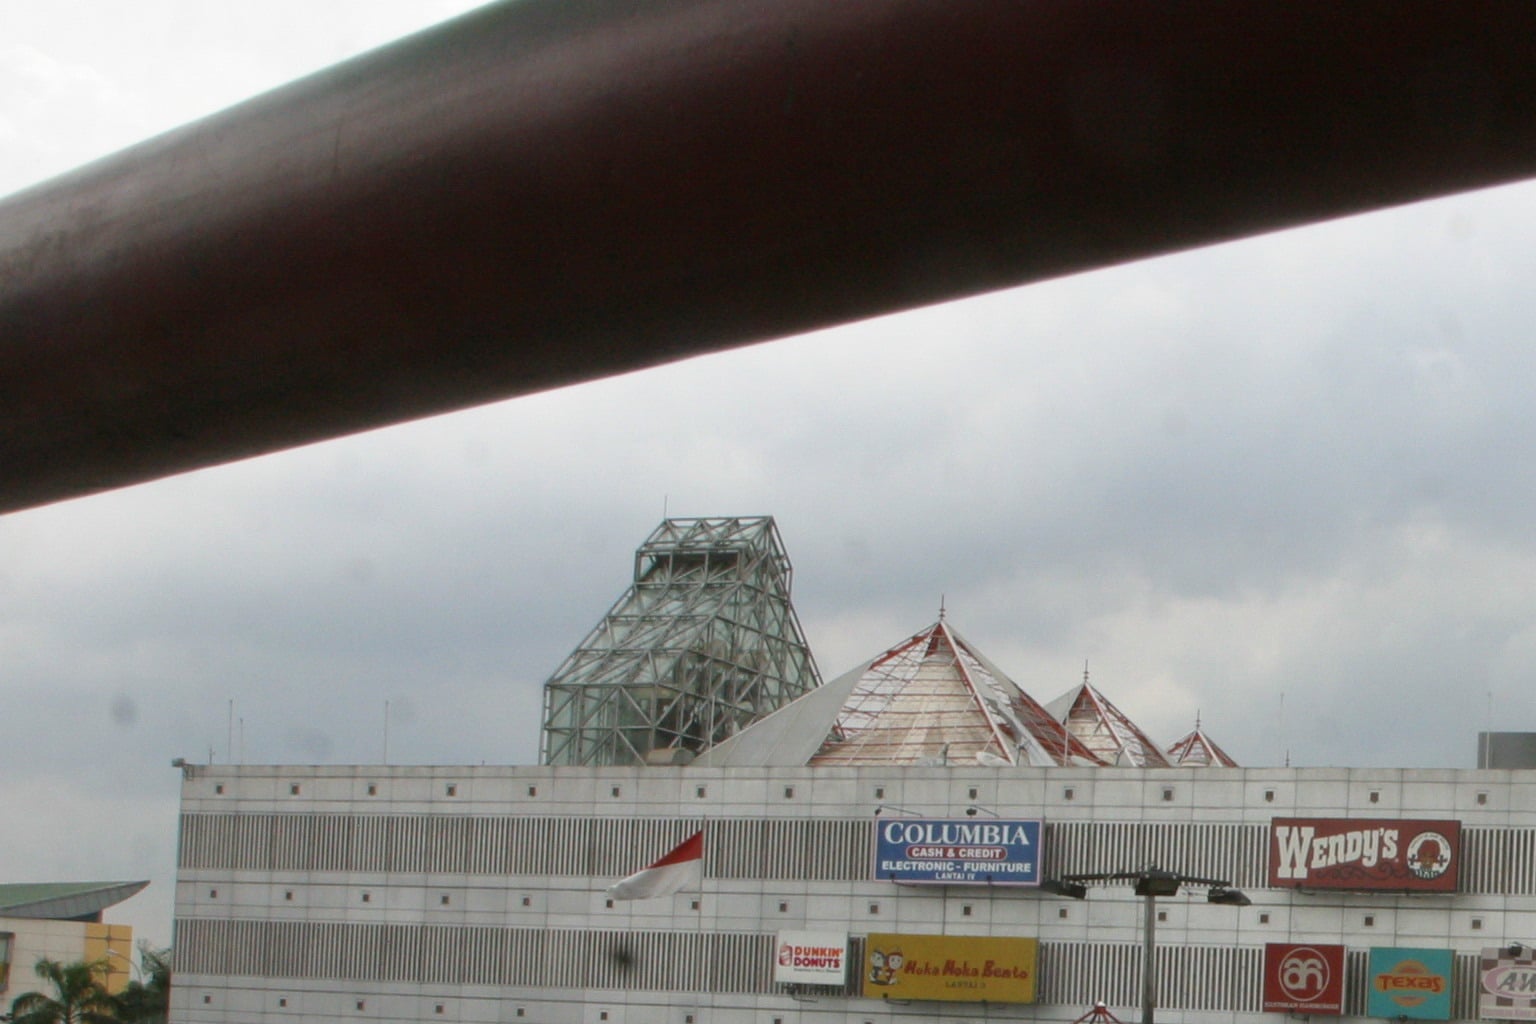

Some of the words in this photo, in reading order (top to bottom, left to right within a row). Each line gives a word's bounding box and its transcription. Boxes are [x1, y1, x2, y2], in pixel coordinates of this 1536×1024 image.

[884, 821, 1030, 846] COLUMBIA
[911, 847, 943, 858] CASH
[946, 848, 955, 858] &
[958, 848, 1002, 859] CREDIT
[882, 860, 955, 872] ELECTRONIC
[963, 862, 1032, 873] FURNITURE
[794, 946, 844, 957] DUNKIN'
[794, 957, 840, 969] DONUTS
[982, 960, 1029, 979] Bento
